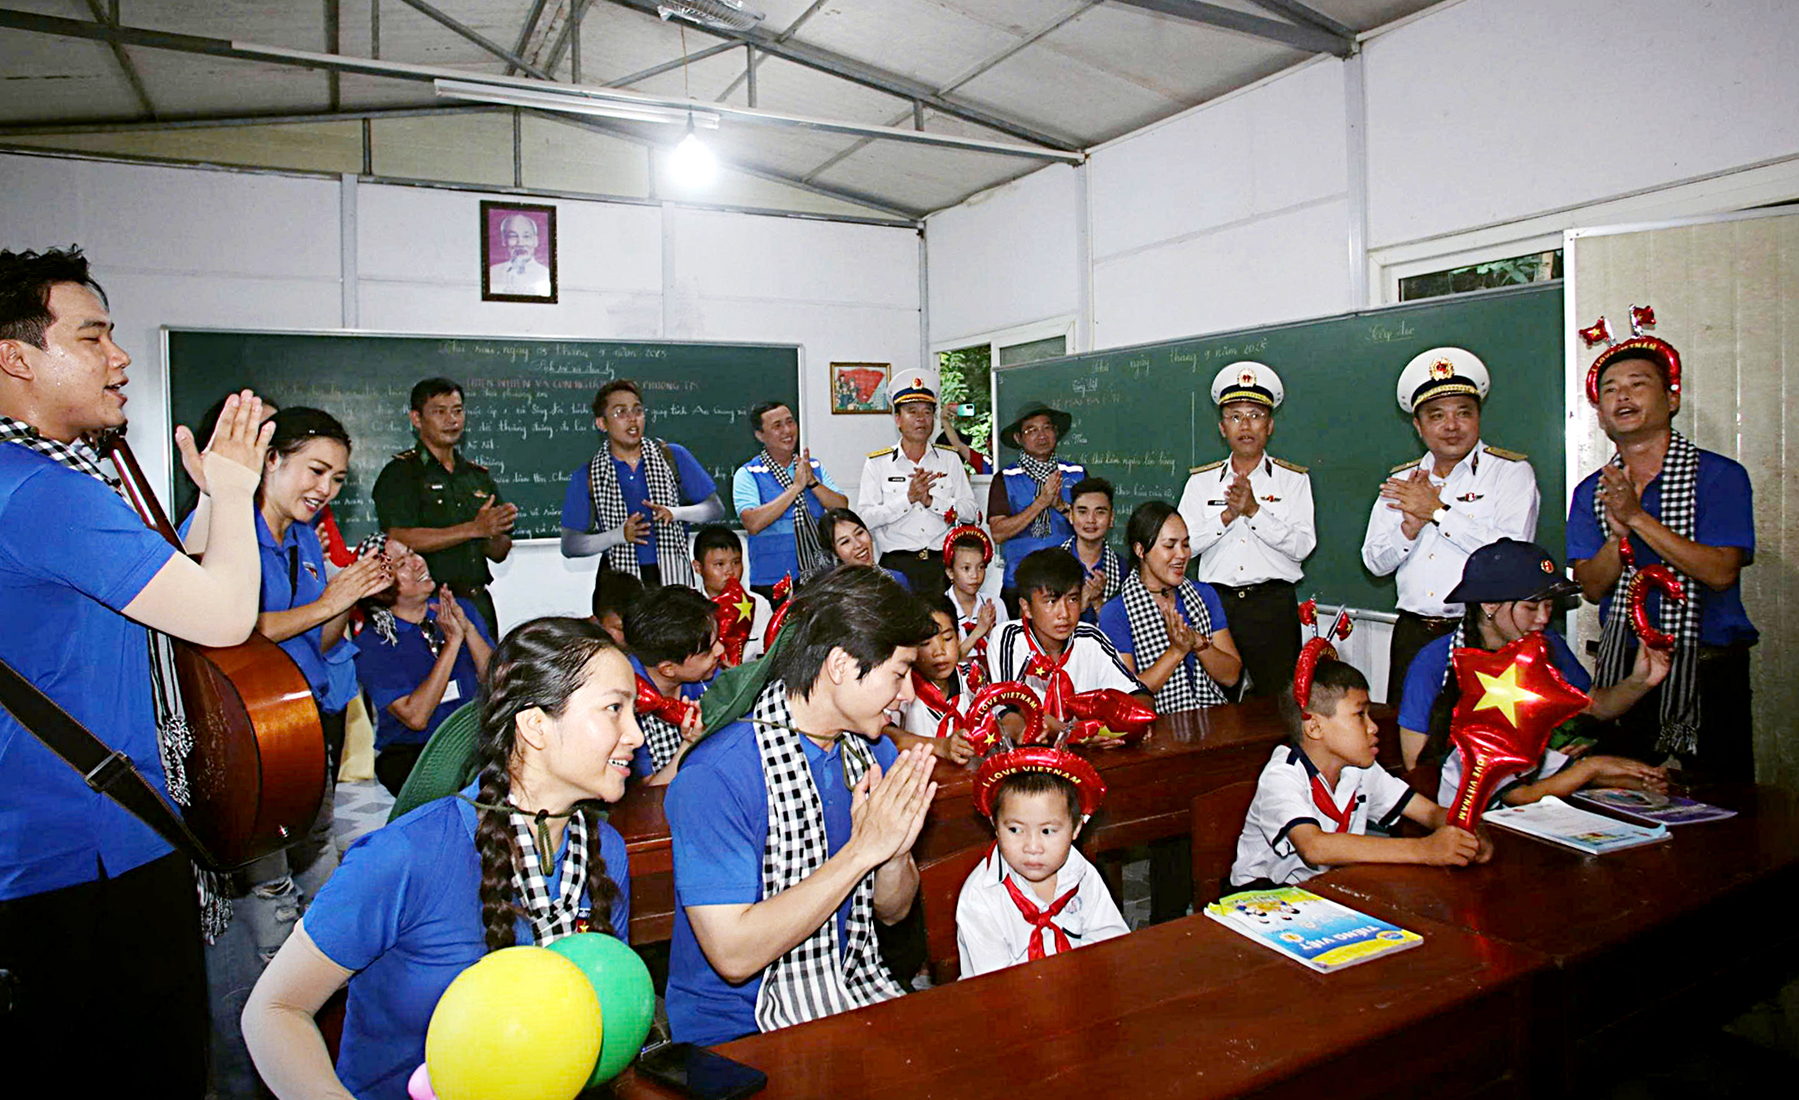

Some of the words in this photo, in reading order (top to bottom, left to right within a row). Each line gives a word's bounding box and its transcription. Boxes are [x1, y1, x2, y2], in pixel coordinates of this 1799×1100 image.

[965, 530, 988, 542] VIETNAM
[977, 693, 999, 716] LOVE
[1000, 691, 1038, 711] VIETNAM
[987, 767, 1018, 784] LOVE
[1022, 765, 1082, 784] VIETNAM
[1471, 753, 1489, 778] LOVE
[1457, 780, 1479, 820] VIETNAM
[1332, 925, 1381, 941] TIẾNG
[1299, 936, 1336, 951] VIỆT
